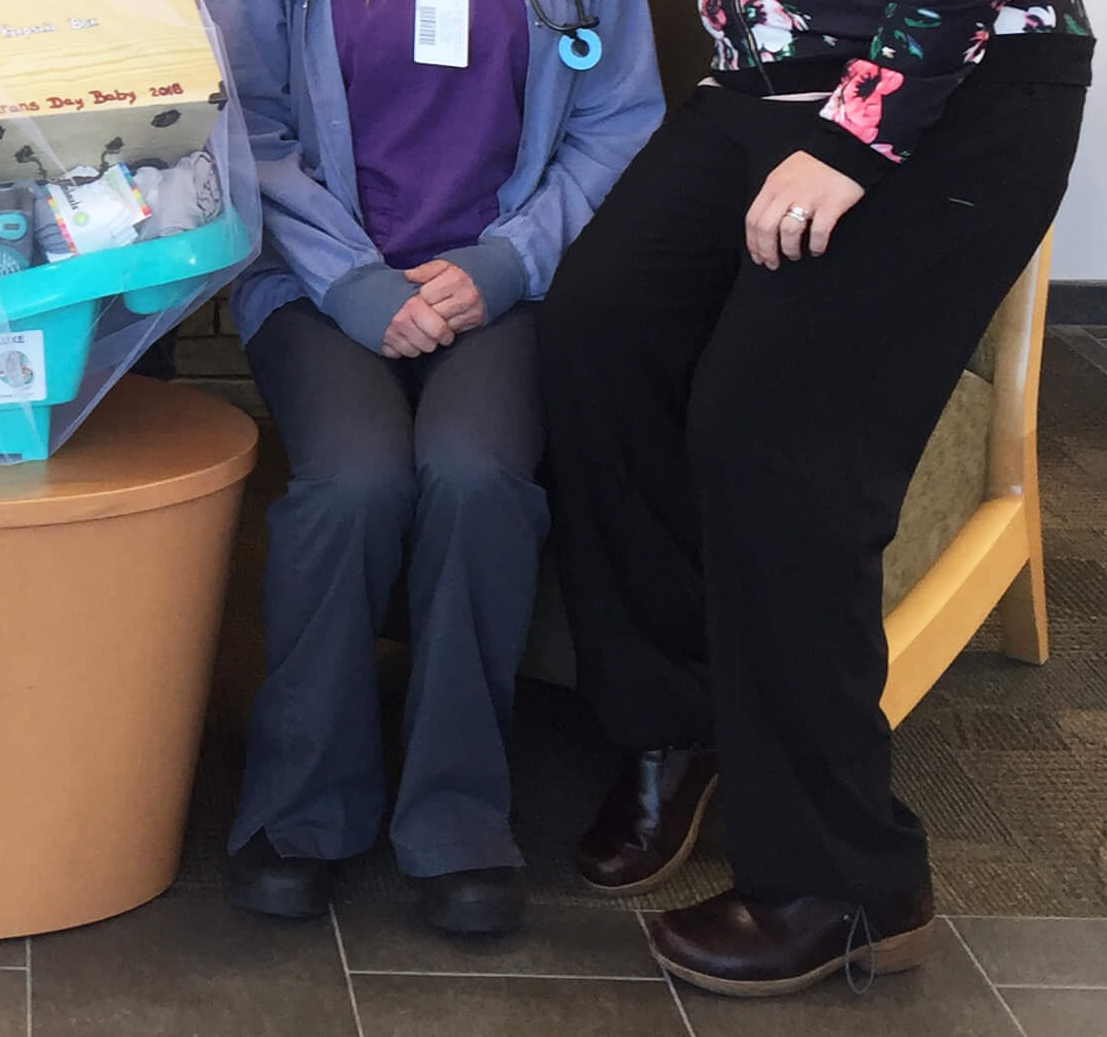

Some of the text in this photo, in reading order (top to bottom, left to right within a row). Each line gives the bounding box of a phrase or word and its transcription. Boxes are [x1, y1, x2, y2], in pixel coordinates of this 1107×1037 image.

[46, 96, 84, 110] Day
[89, 89, 137, 105] Baby
[150, 82, 184, 96] 2018
